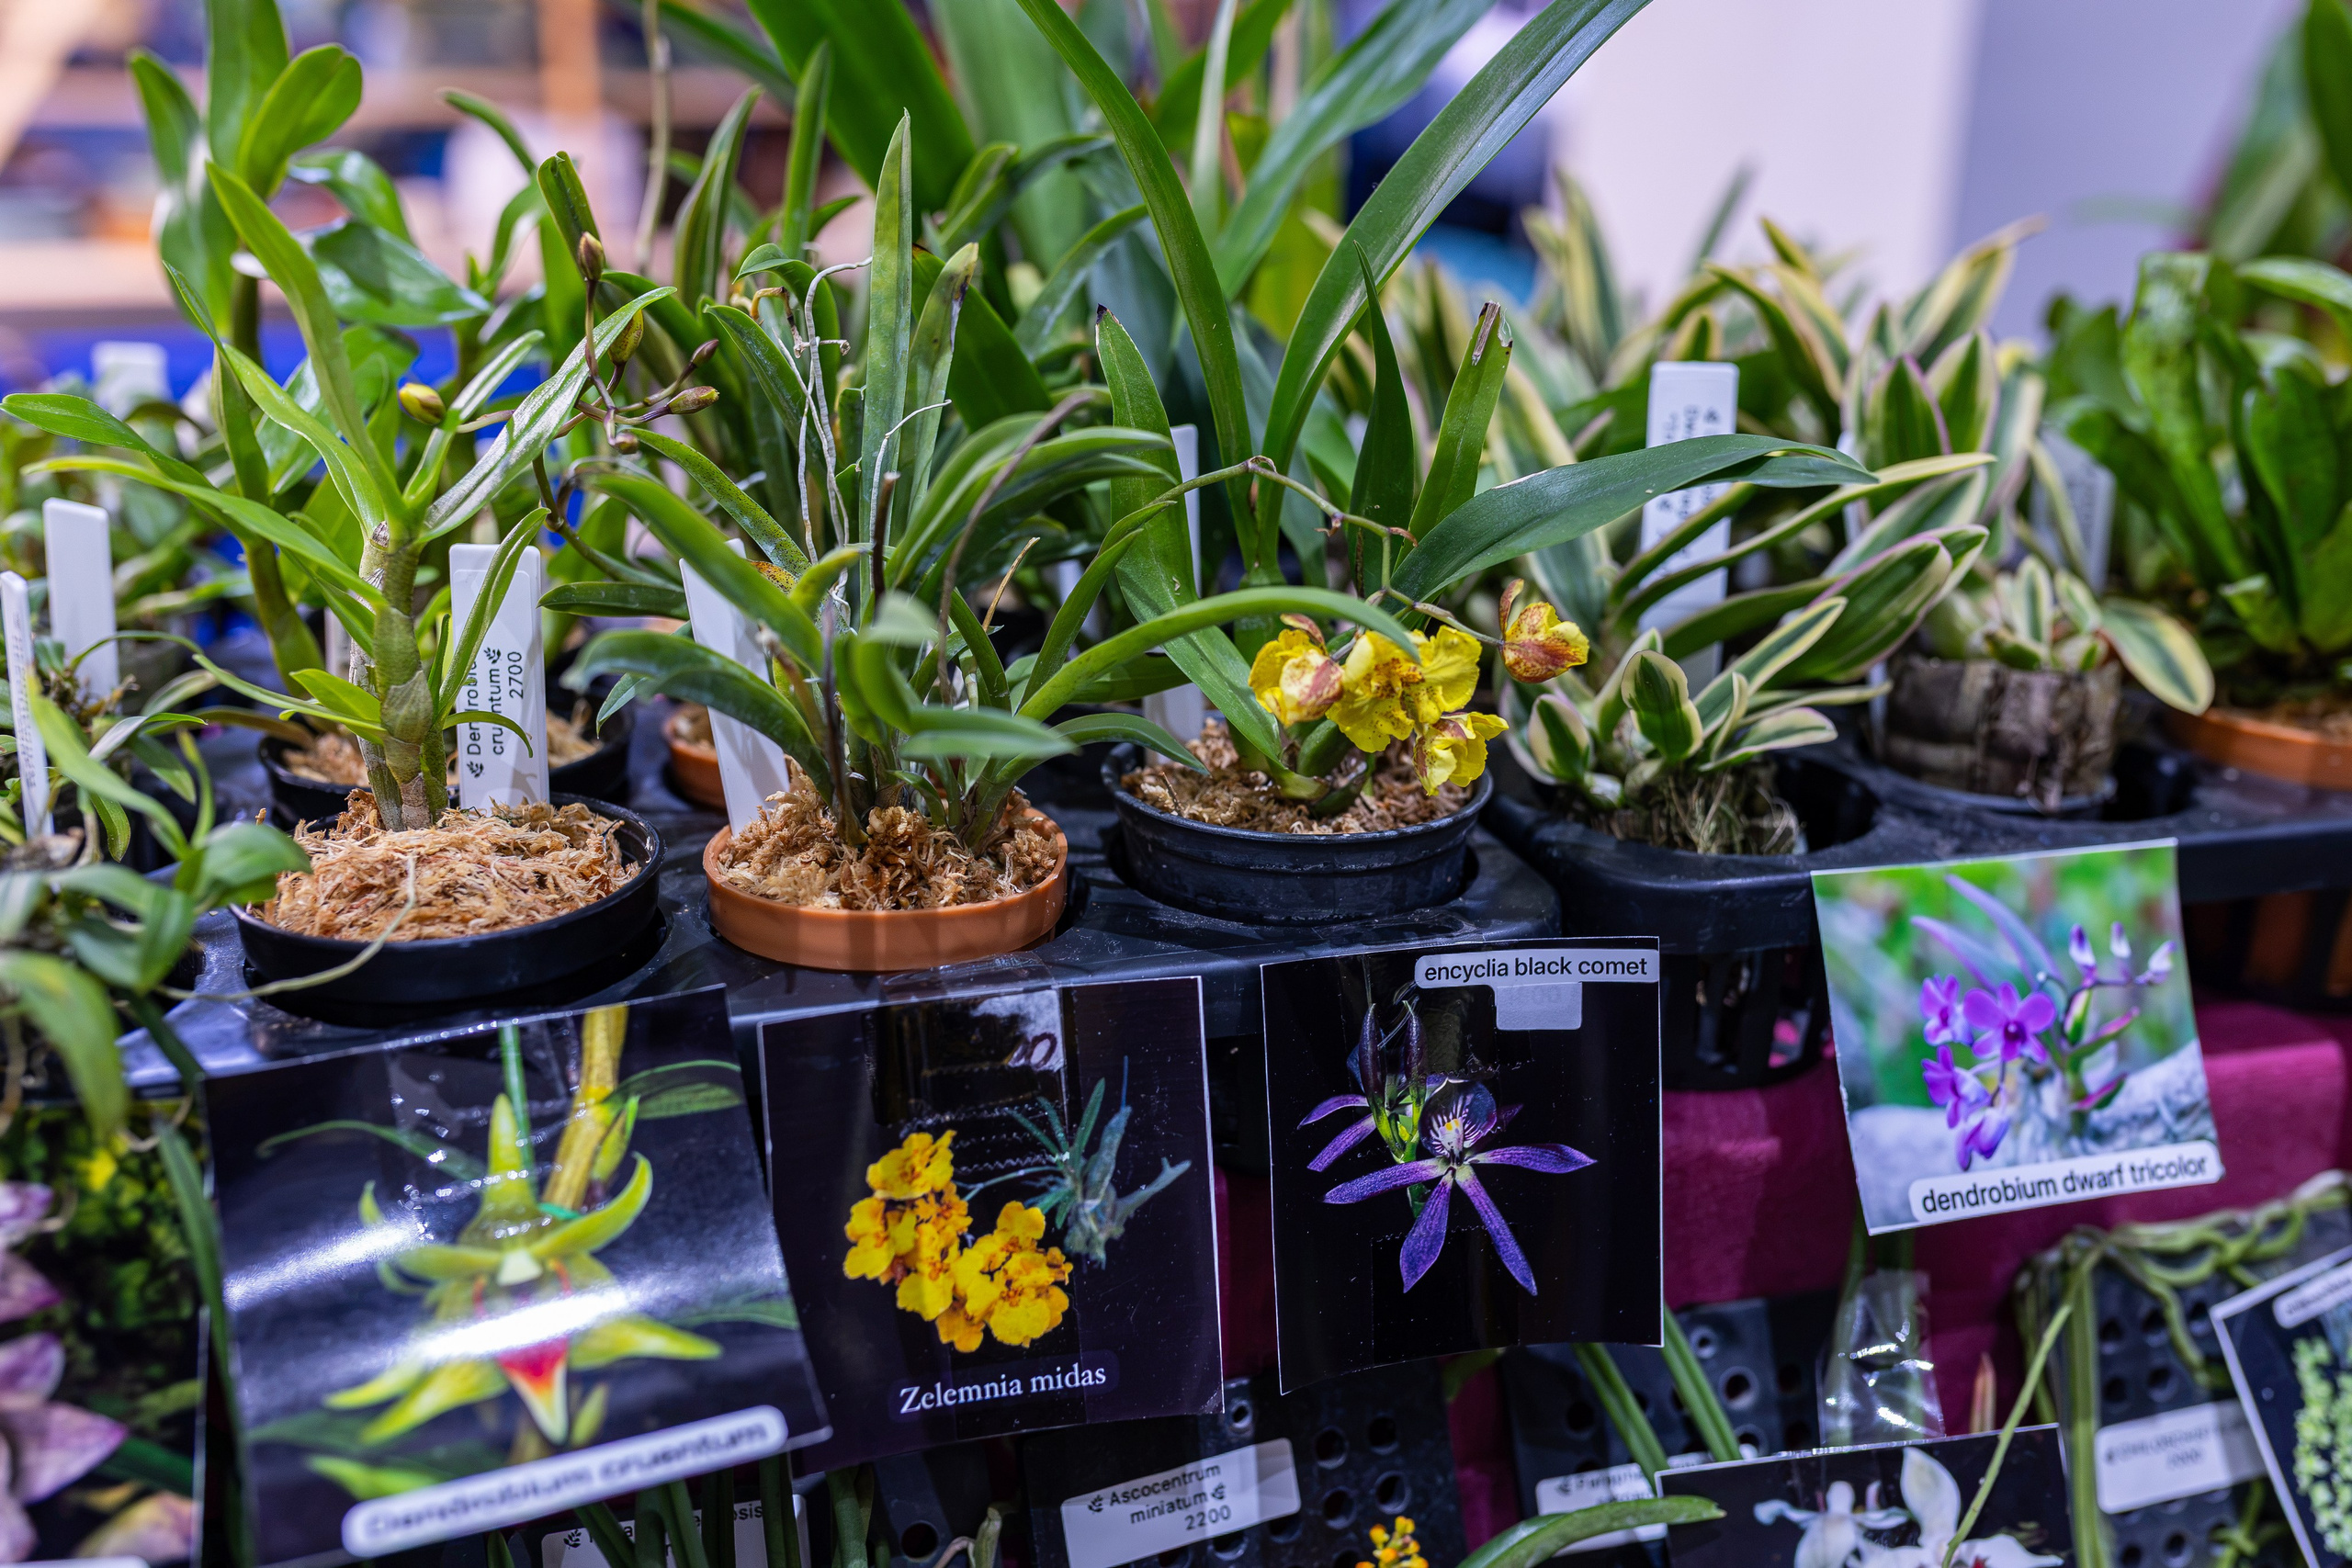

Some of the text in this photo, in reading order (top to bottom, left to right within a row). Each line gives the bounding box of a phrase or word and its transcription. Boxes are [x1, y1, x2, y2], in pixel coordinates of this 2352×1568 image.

[507, 650, 525, 700] 2700
[488, 668, 504, 756] cruntum
[1425, 956, 1647, 983] encyclia black comet
[1922, 1155, 2208, 1213] dendrobium dwarf tricolor
[899, 1361, 1106, 1414] Zelemnia midas
[1109, 1464, 1222, 1506] Ascocentrum
[1130, 1490, 1208, 1525] miniatum
[1184, 1505, 1232, 1531] 2200
